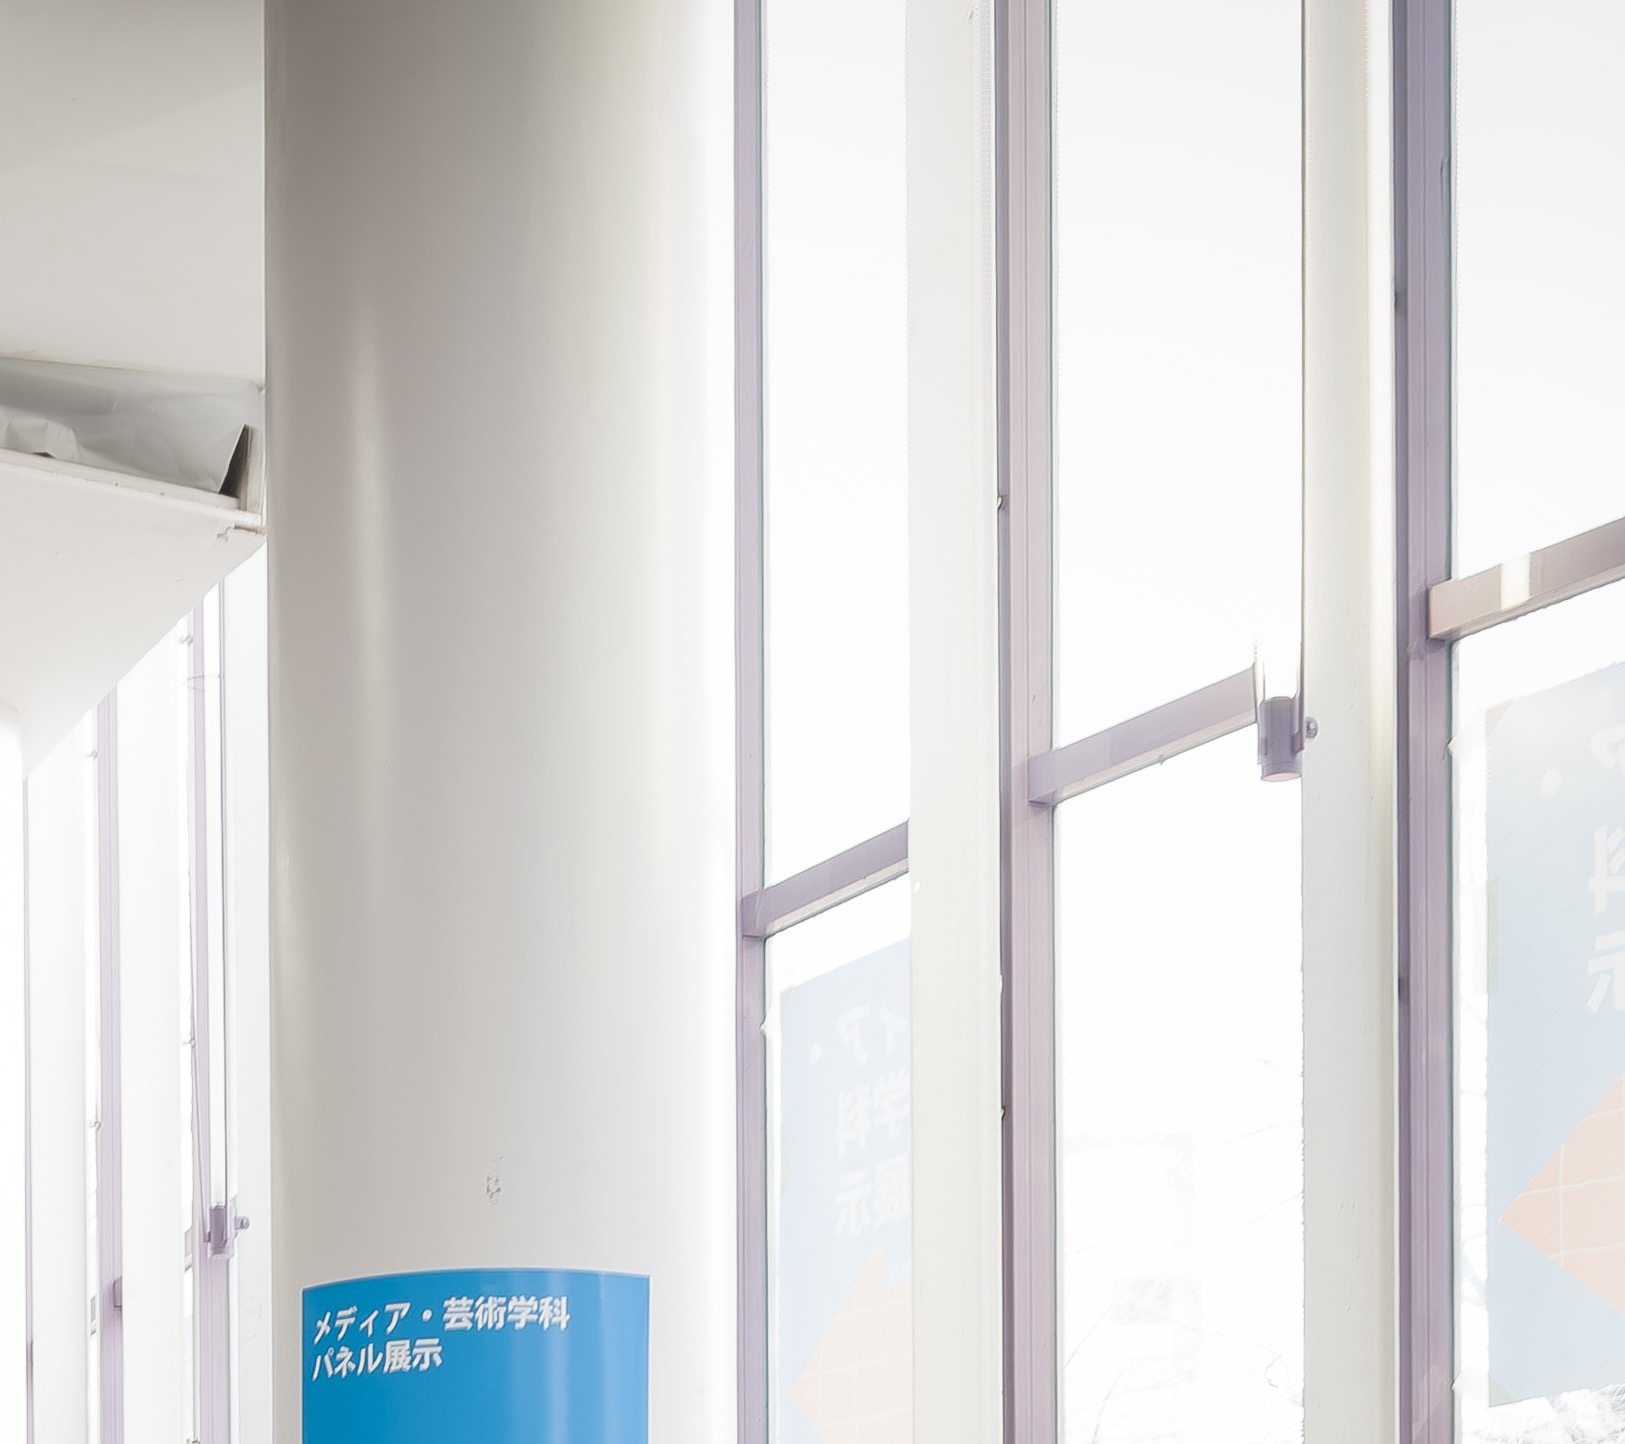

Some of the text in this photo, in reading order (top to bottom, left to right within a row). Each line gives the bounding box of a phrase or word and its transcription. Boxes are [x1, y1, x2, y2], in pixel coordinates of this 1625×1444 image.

[313, 1295, 571, 1345] メディア・芸術学科
[311, 1337, 443, 1381] パネル展示
